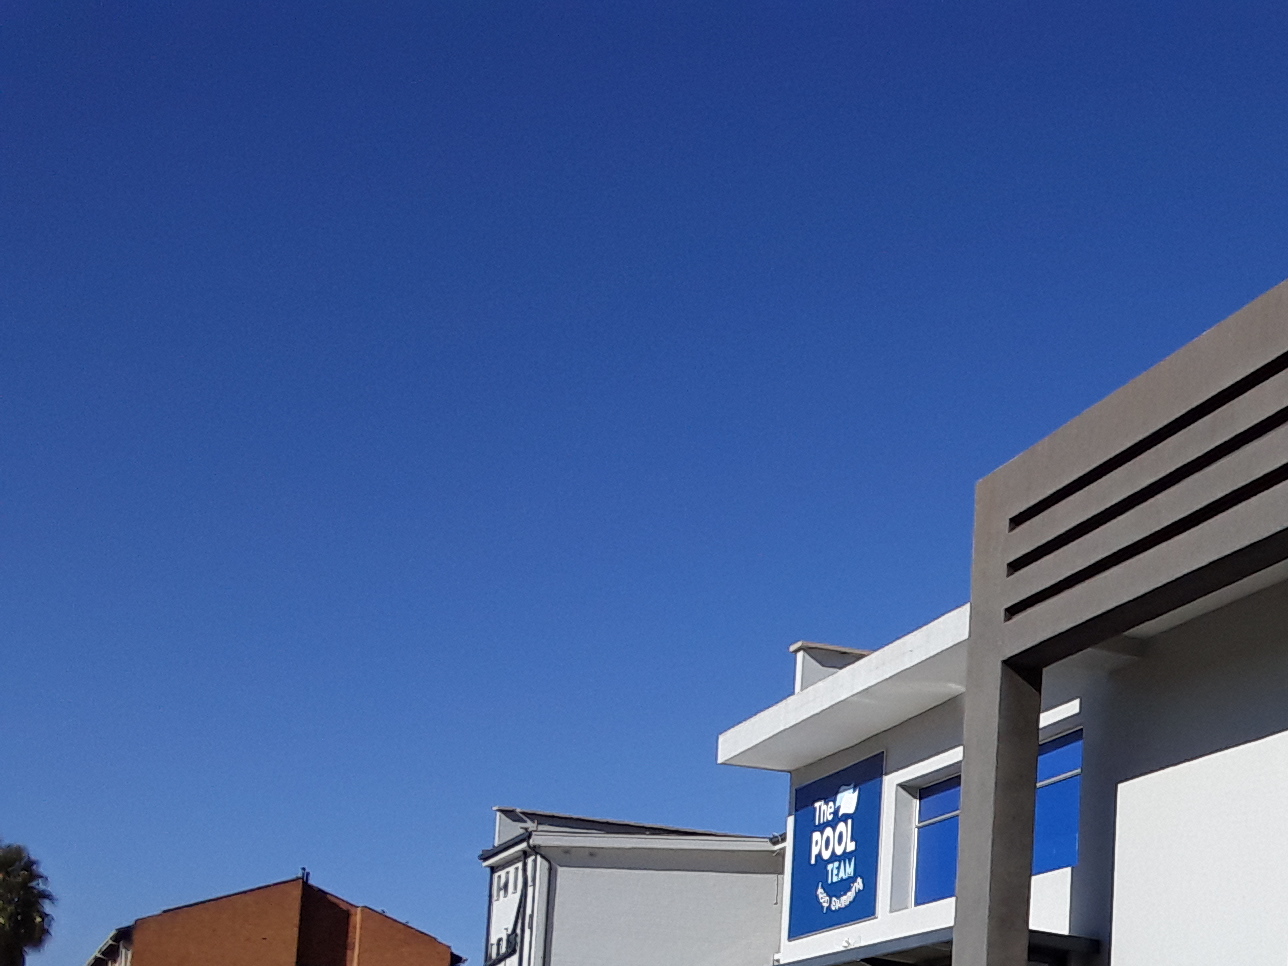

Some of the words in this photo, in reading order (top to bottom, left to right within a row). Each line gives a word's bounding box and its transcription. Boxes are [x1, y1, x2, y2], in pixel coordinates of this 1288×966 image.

[813, 800, 835, 826] The
[810, 818, 856, 865] POOL
[826, 856, 855, 884] TEAM
